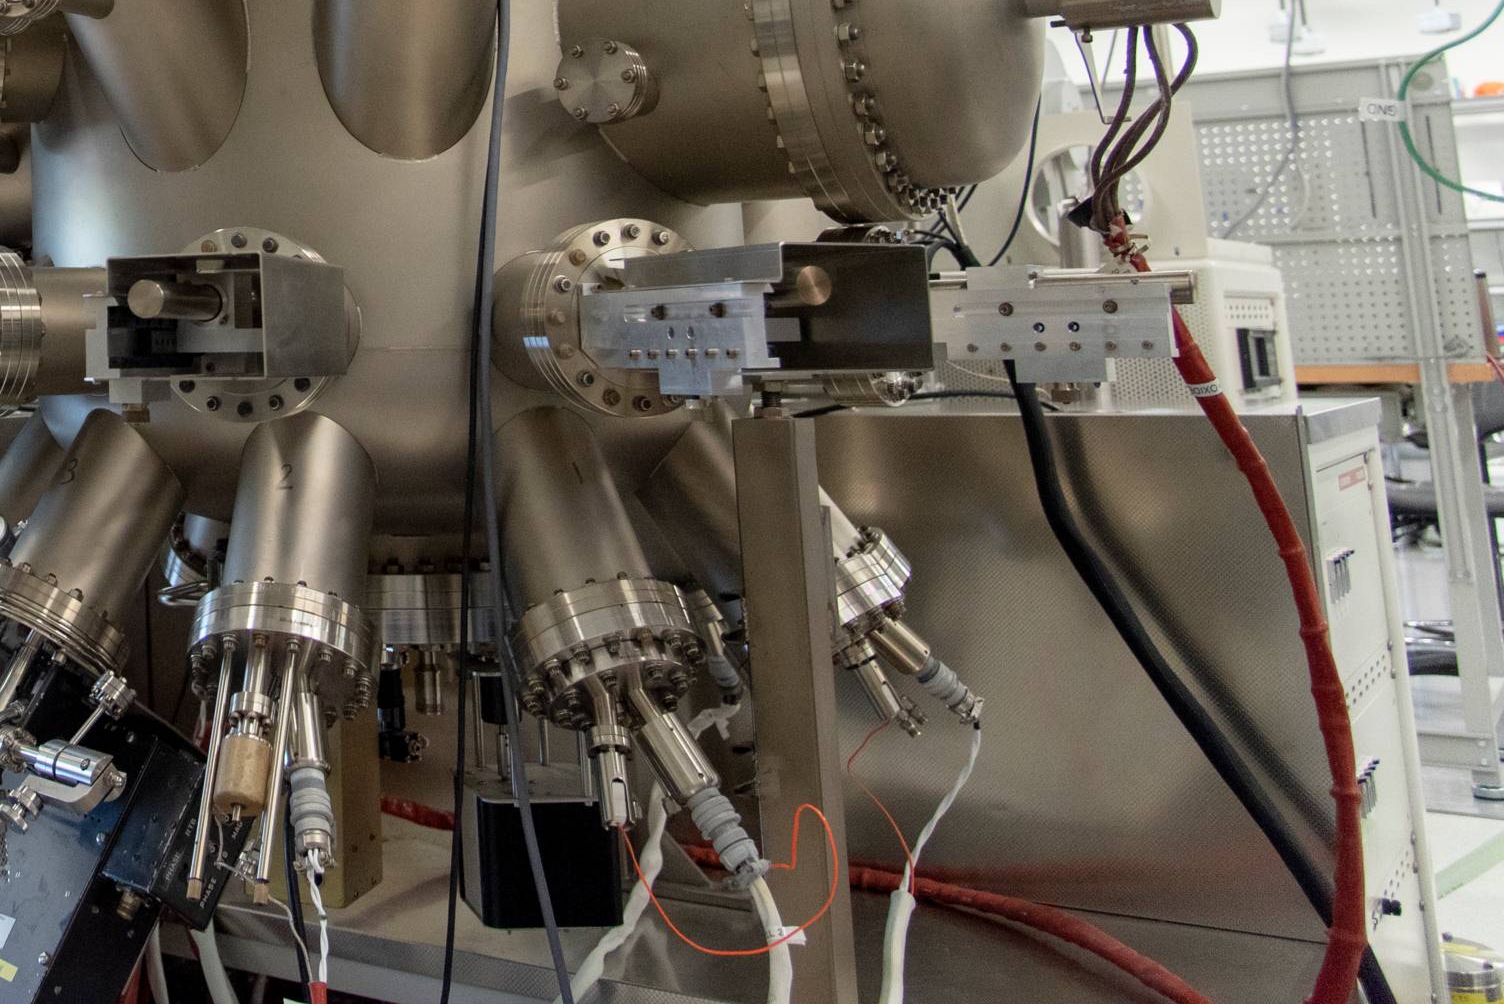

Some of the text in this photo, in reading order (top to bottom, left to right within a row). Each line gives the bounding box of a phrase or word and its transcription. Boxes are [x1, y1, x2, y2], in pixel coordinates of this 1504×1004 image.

[60, 457, 78, 485] 3
[278, 463, 294, 490] 2
[165, 851, 181, 881] PHASE
[198, 877, 217, 909] PHASE
